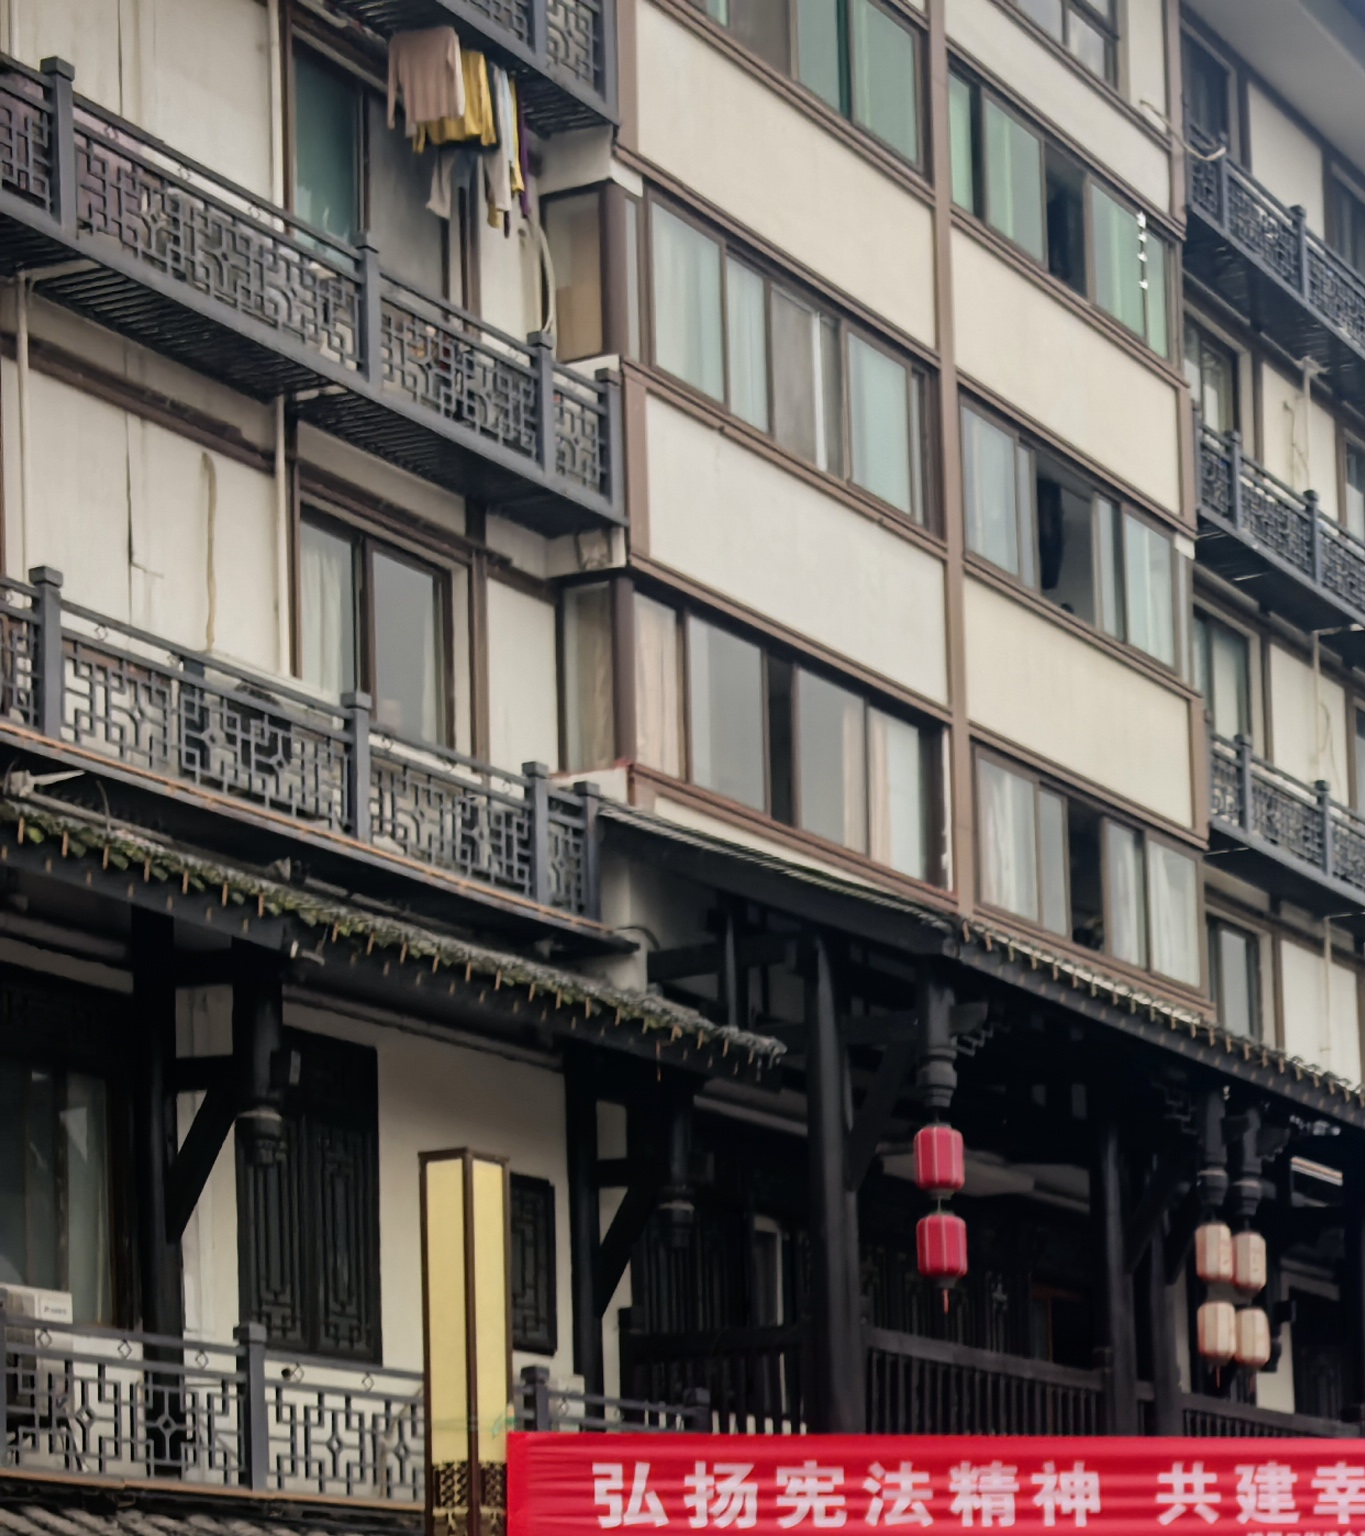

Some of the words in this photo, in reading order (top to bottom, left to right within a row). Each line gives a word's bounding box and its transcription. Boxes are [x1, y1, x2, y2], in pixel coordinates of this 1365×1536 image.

[592, 1460, 1100, 1530] 弘扬宪法精神
